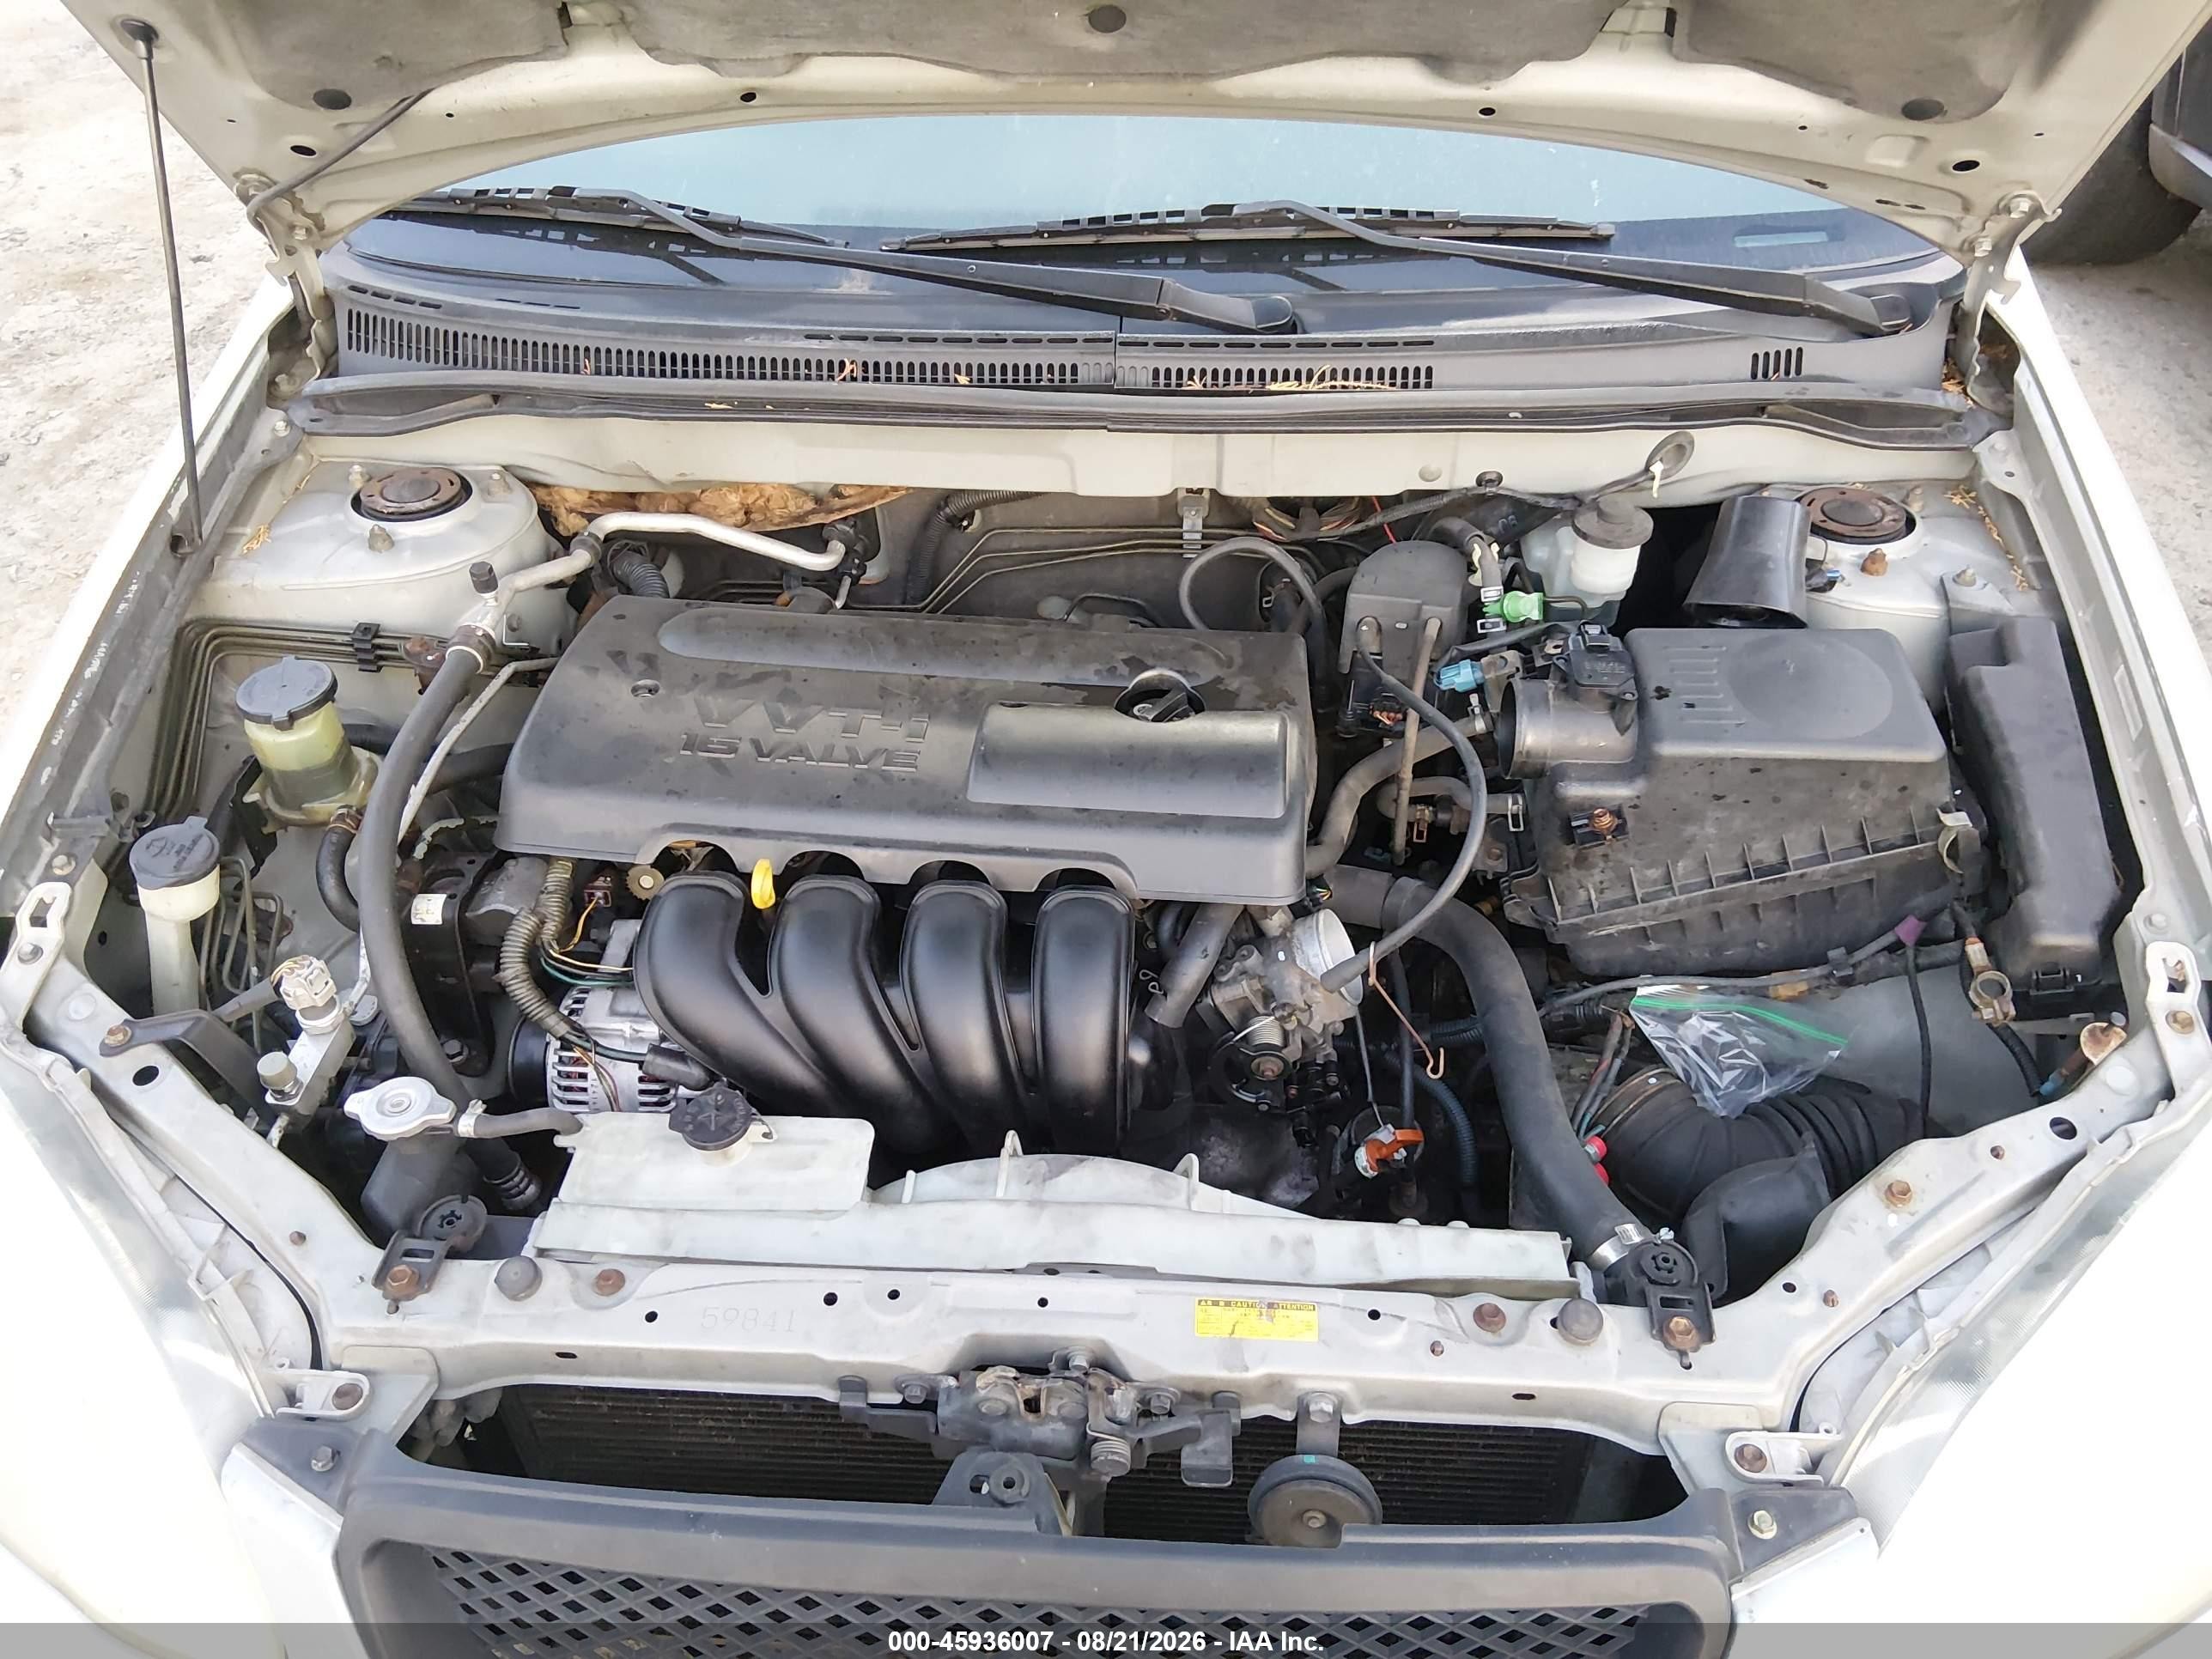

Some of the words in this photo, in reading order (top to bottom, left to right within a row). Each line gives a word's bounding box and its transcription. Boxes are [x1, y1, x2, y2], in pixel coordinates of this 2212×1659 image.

[680, 732, 742, 759] 16
[749, 737, 921, 772] VALVE
[1273, 1302, 1314, 1311] ATTENTION
